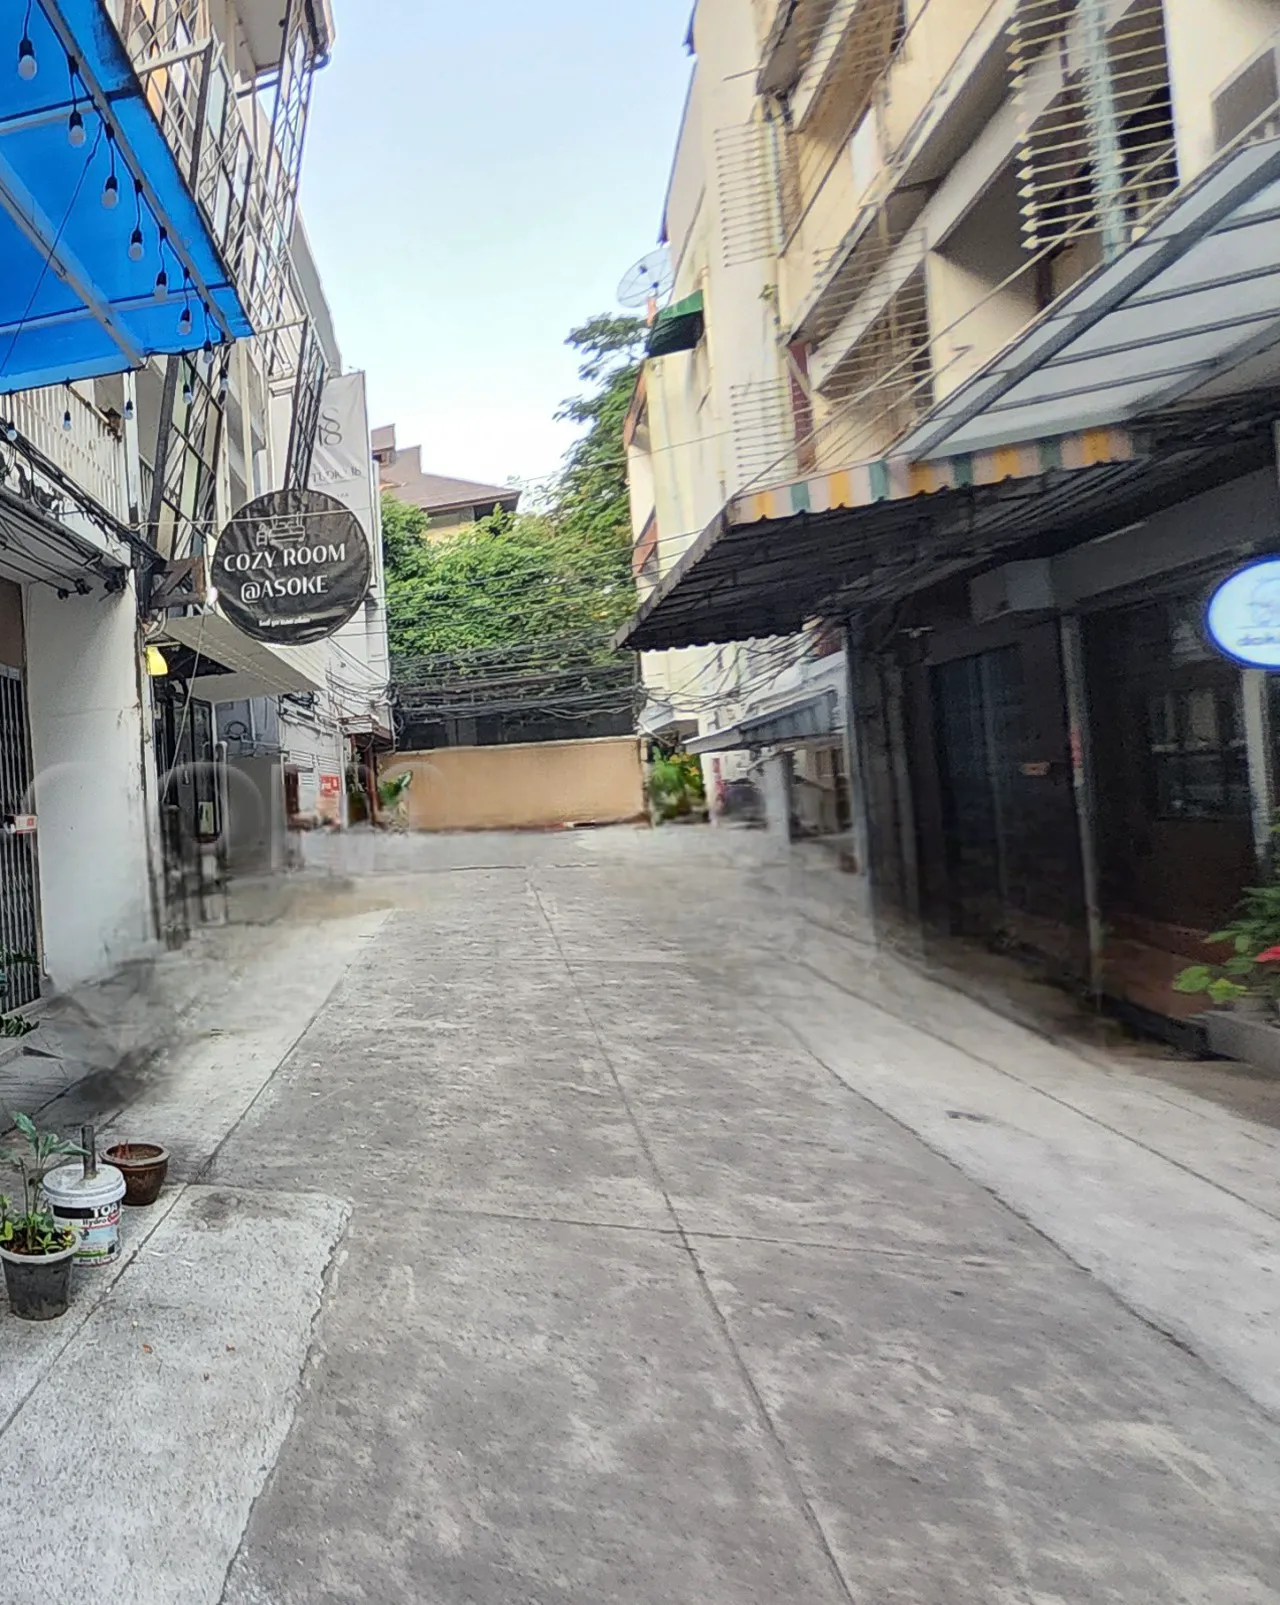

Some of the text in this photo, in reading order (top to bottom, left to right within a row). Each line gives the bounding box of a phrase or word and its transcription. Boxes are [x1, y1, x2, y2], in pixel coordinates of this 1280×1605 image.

[224, 543, 345, 572] COZY ROOM
[241, 575, 328, 603] @ASOKE
[91, 1202, 118, 1218] TOA
